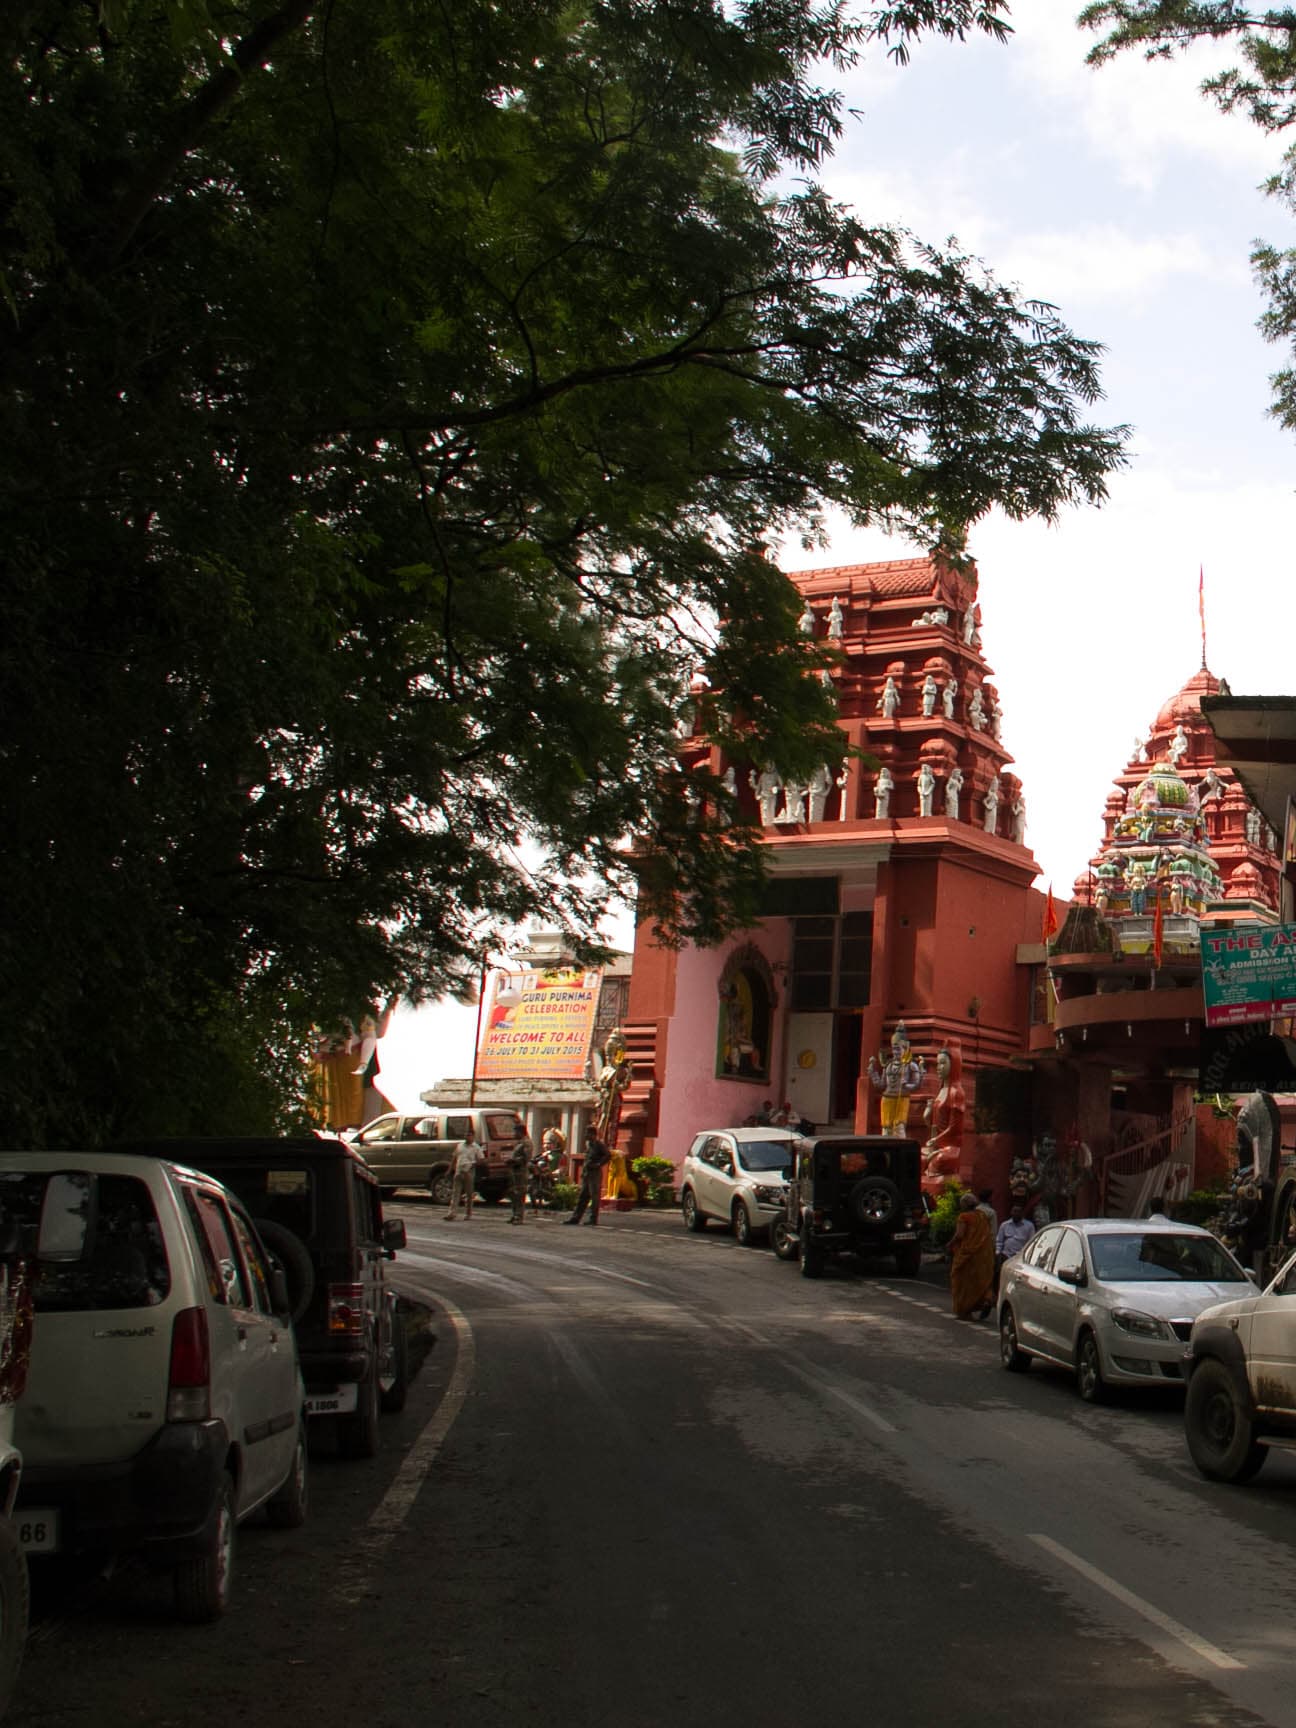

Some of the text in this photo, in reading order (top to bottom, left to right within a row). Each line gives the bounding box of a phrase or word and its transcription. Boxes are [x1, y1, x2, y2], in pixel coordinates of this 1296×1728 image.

[1208, 935, 1263, 953] THE
[1250, 948, 1278, 959] DAY
[1230, 957, 1289, 970] ADMISSION
[522, 991, 592, 1003] GURU PURNIMA
[524, 1003, 587, 1014] CELEBRATION
[489, 1031, 586, 1044] WELCOME TO ALL
[496, 1047, 516, 1056] JULY
[518, 1046, 529, 1056] TO
[529, 1046, 540, 1056] 31
[540, 1046, 560, 1056] JULY
[562, 1046, 583, 1055] 2015
